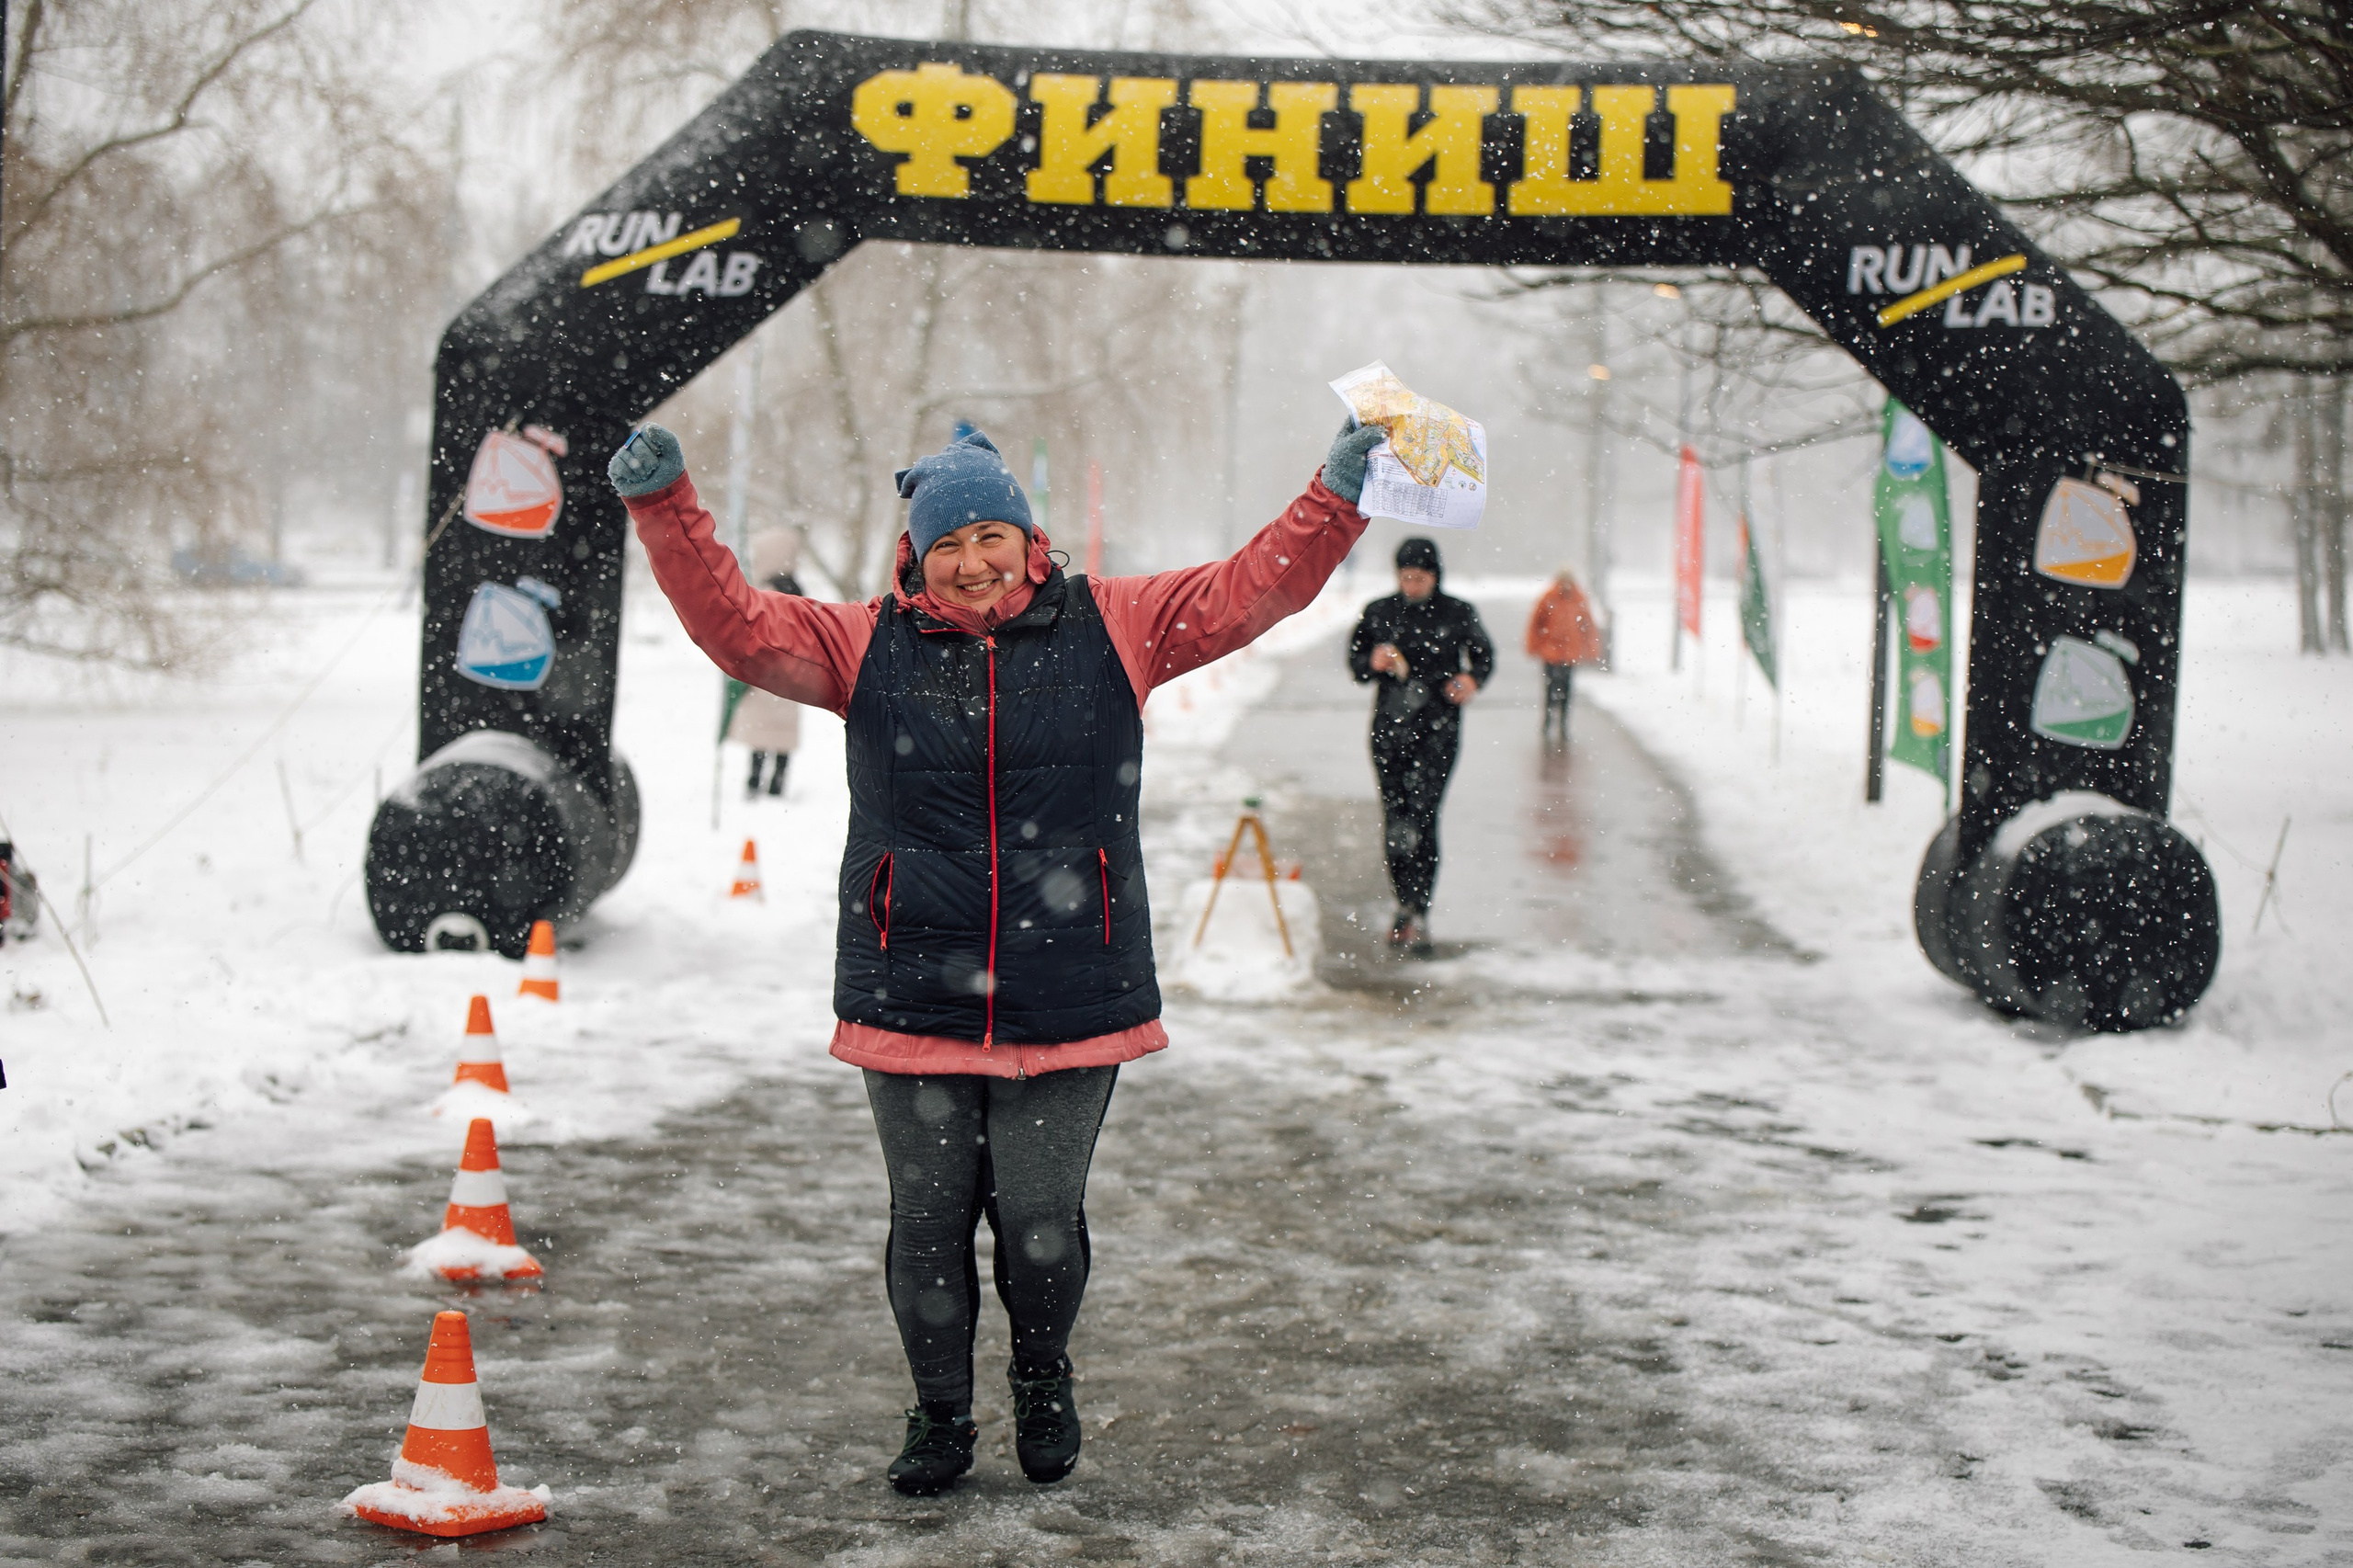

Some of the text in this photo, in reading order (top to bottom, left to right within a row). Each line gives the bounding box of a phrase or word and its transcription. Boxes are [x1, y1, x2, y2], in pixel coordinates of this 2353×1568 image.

[851, 62, 1736, 218] ФИНИШ
[563, 210, 683, 257] RUN
[645, 249, 760, 298] LAB
[1846, 243, 1972, 295] RUN
[1942, 278, 2057, 328] LAB
